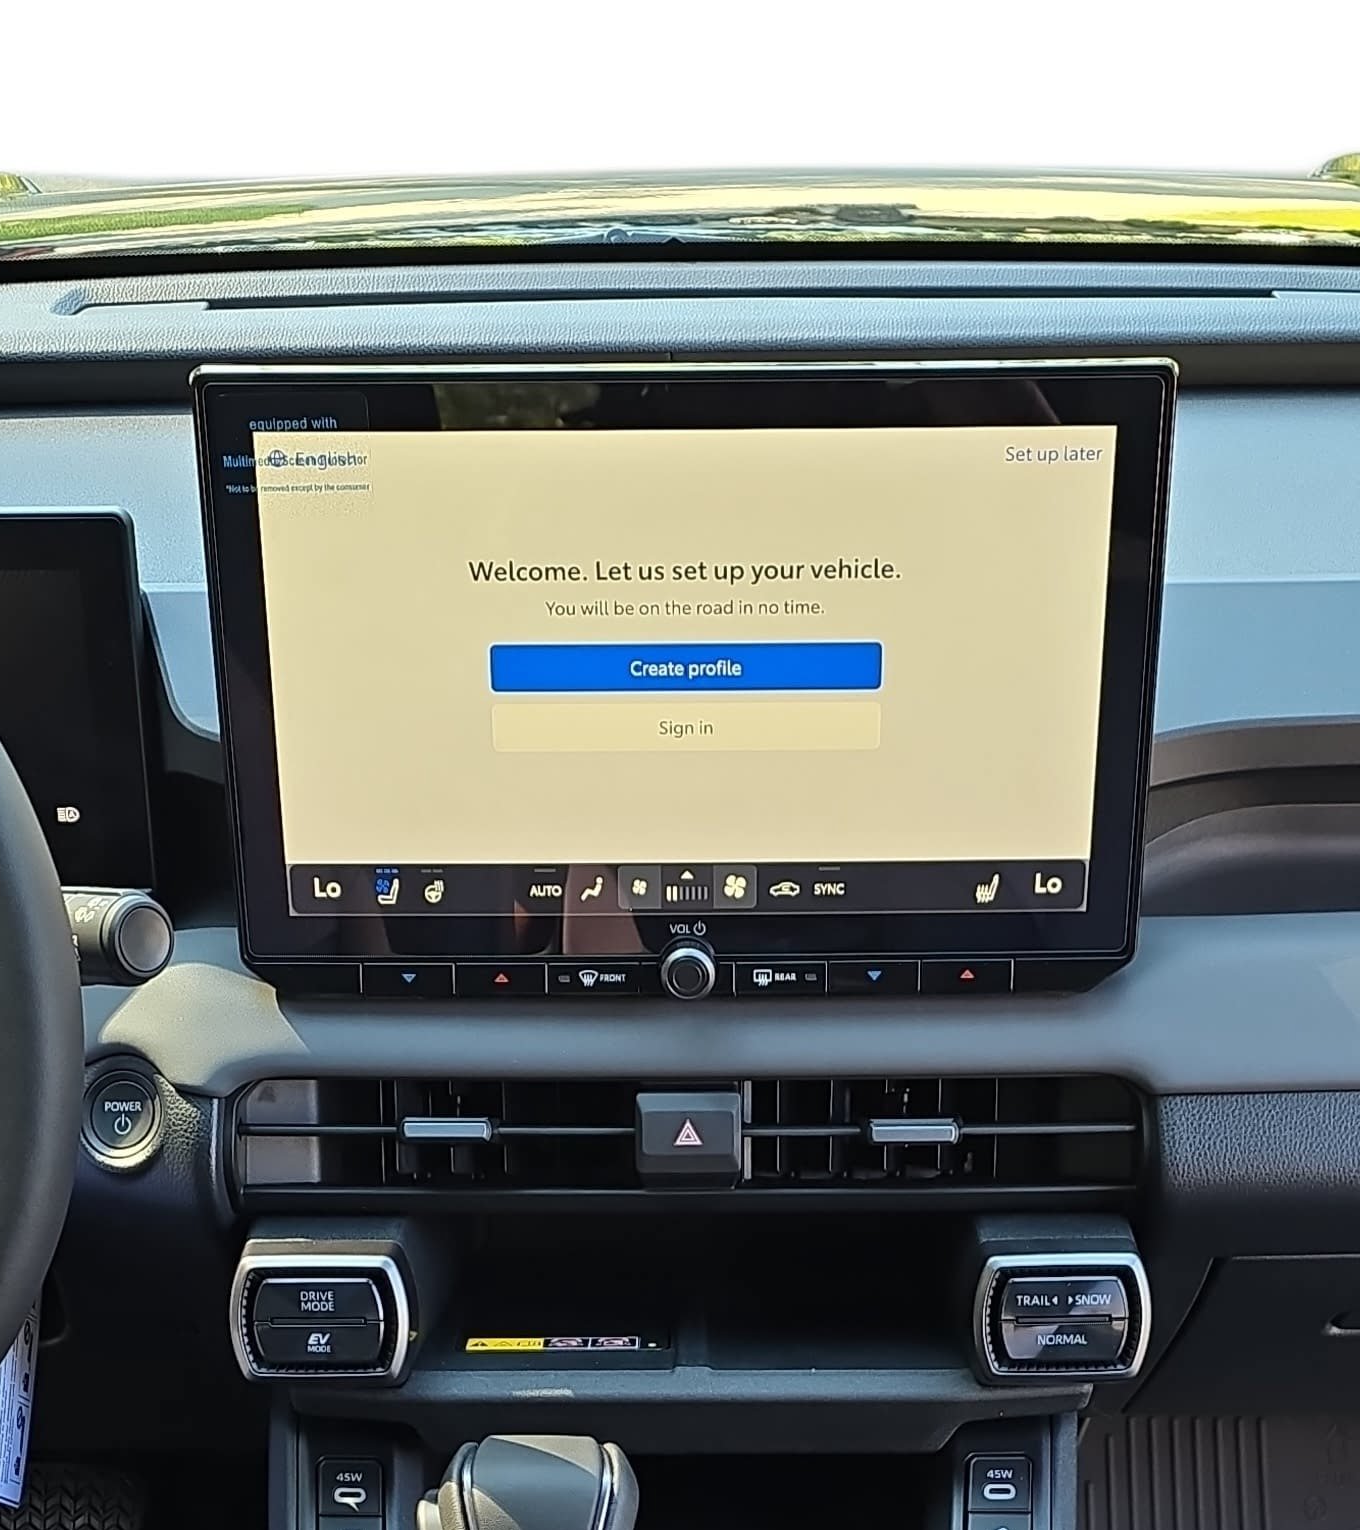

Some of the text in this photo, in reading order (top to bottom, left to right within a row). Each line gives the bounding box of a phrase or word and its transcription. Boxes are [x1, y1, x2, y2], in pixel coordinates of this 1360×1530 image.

[249, 417, 338, 431] equipped with
[295, 451, 357, 470] English
[1005, 445, 1102, 464] Set up later
[260, 484, 289, 493] removed
[291, 484, 314, 494] except
[323, 484, 335, 492] the
[468, 558, 902, 585] Welcome. Let us set up your vehicle.
[545, 600, 825, 616] You will be on the road in no time.
[630, 659, 742, 679] Create profile
[658, 720, 713, 739] Sign in
[313, 877, 342, 899] Lo
[813, 882, 845, 896] SYNC
[1034, 872, 1063, 895] Lo
[529, 884, 562, 898] AUTO
[669, 923, 691, 935] VOL
[599, 973, 627, 983] FRONT
[774, 972, 797, 982] REAR
[104, 1101, 142, 1112] POWER
[300, 1291, 335, 1301] DRIVE
[1016, 1294, 1111, 1307] TRAIL SNOW
[300, 1301, 335, 1312] MODE
[308, 1333, 331, 1345] EV
[1037, 1334, 1088, 1346] NORMAL
[308, 1345, 332, 1353] MODE
[336, 1472, 363, 1482] 45W
[986, 1469, 1013, 1480] 45W
